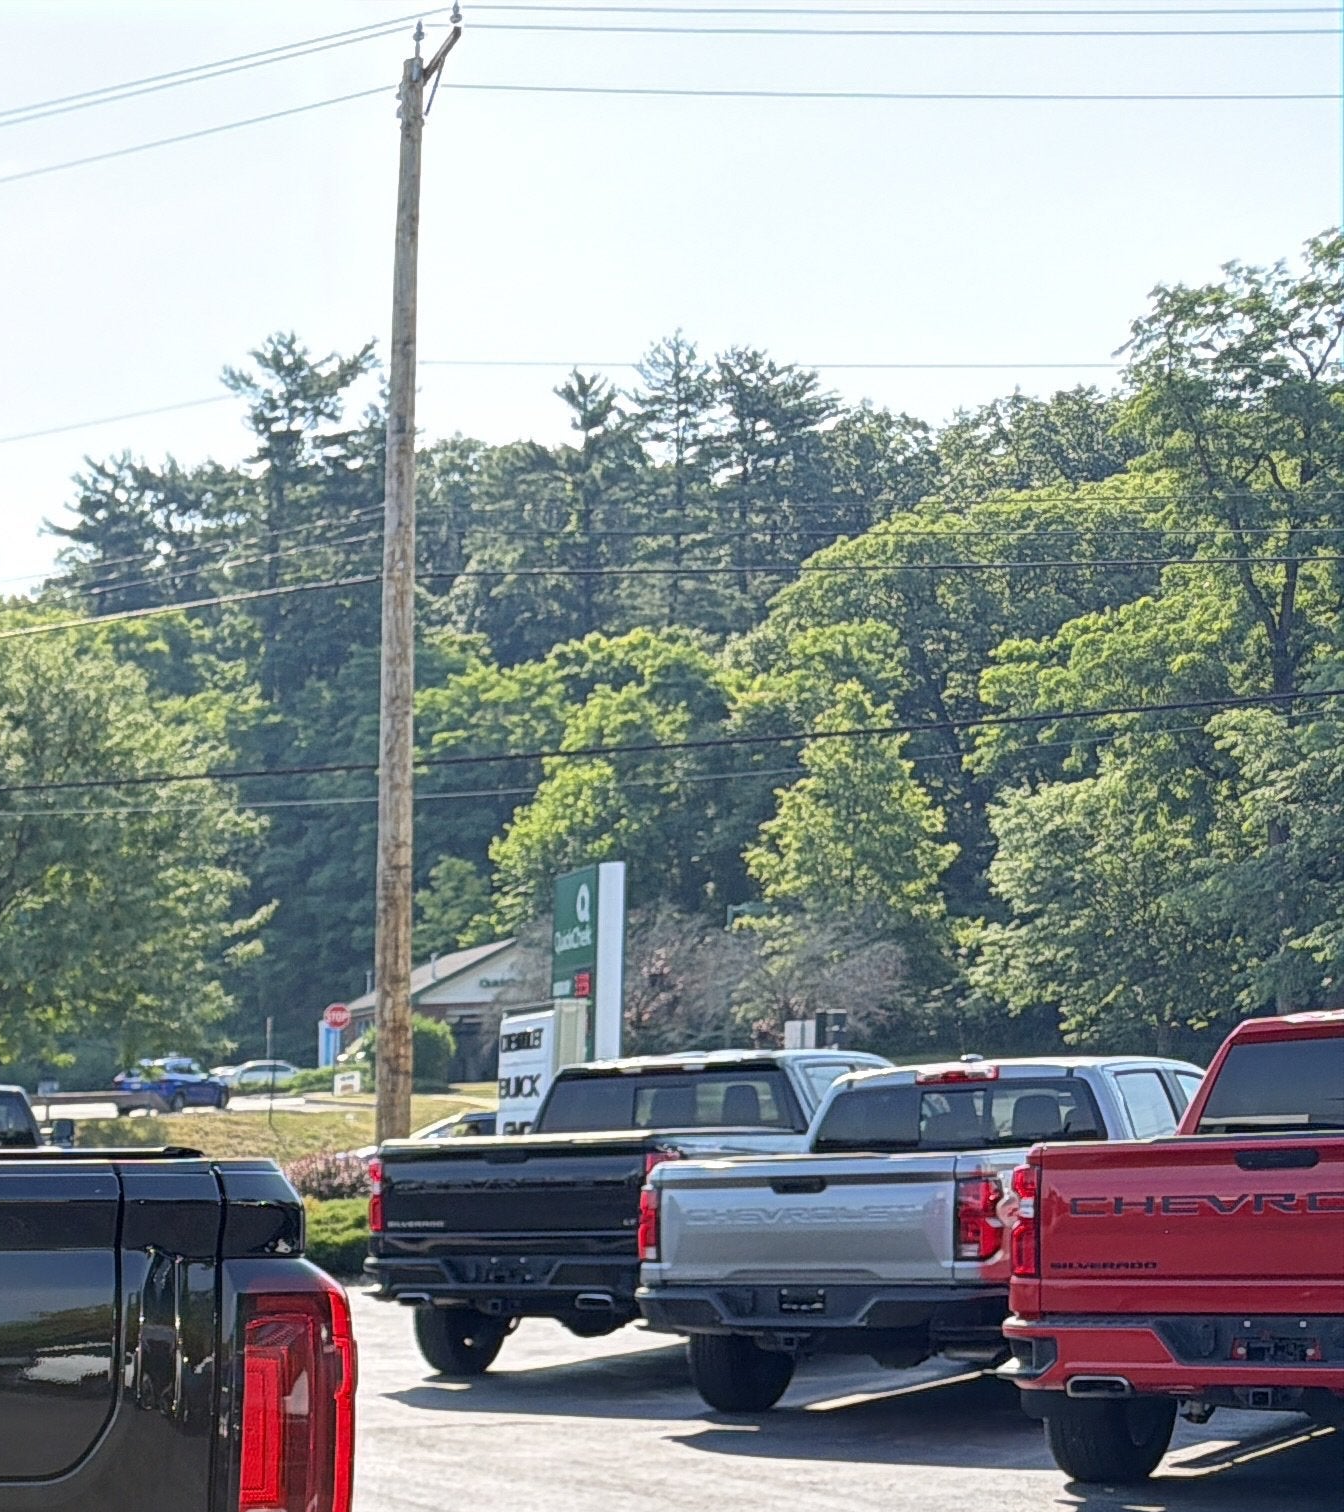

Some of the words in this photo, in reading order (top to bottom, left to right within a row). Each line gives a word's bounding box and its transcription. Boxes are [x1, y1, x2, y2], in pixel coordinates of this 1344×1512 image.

[324, 1009, 352, 1024] STOP
[499, 1073, 542, 1098] BUICK
[1050, 1260, 1158, 1270] SILVERADO
